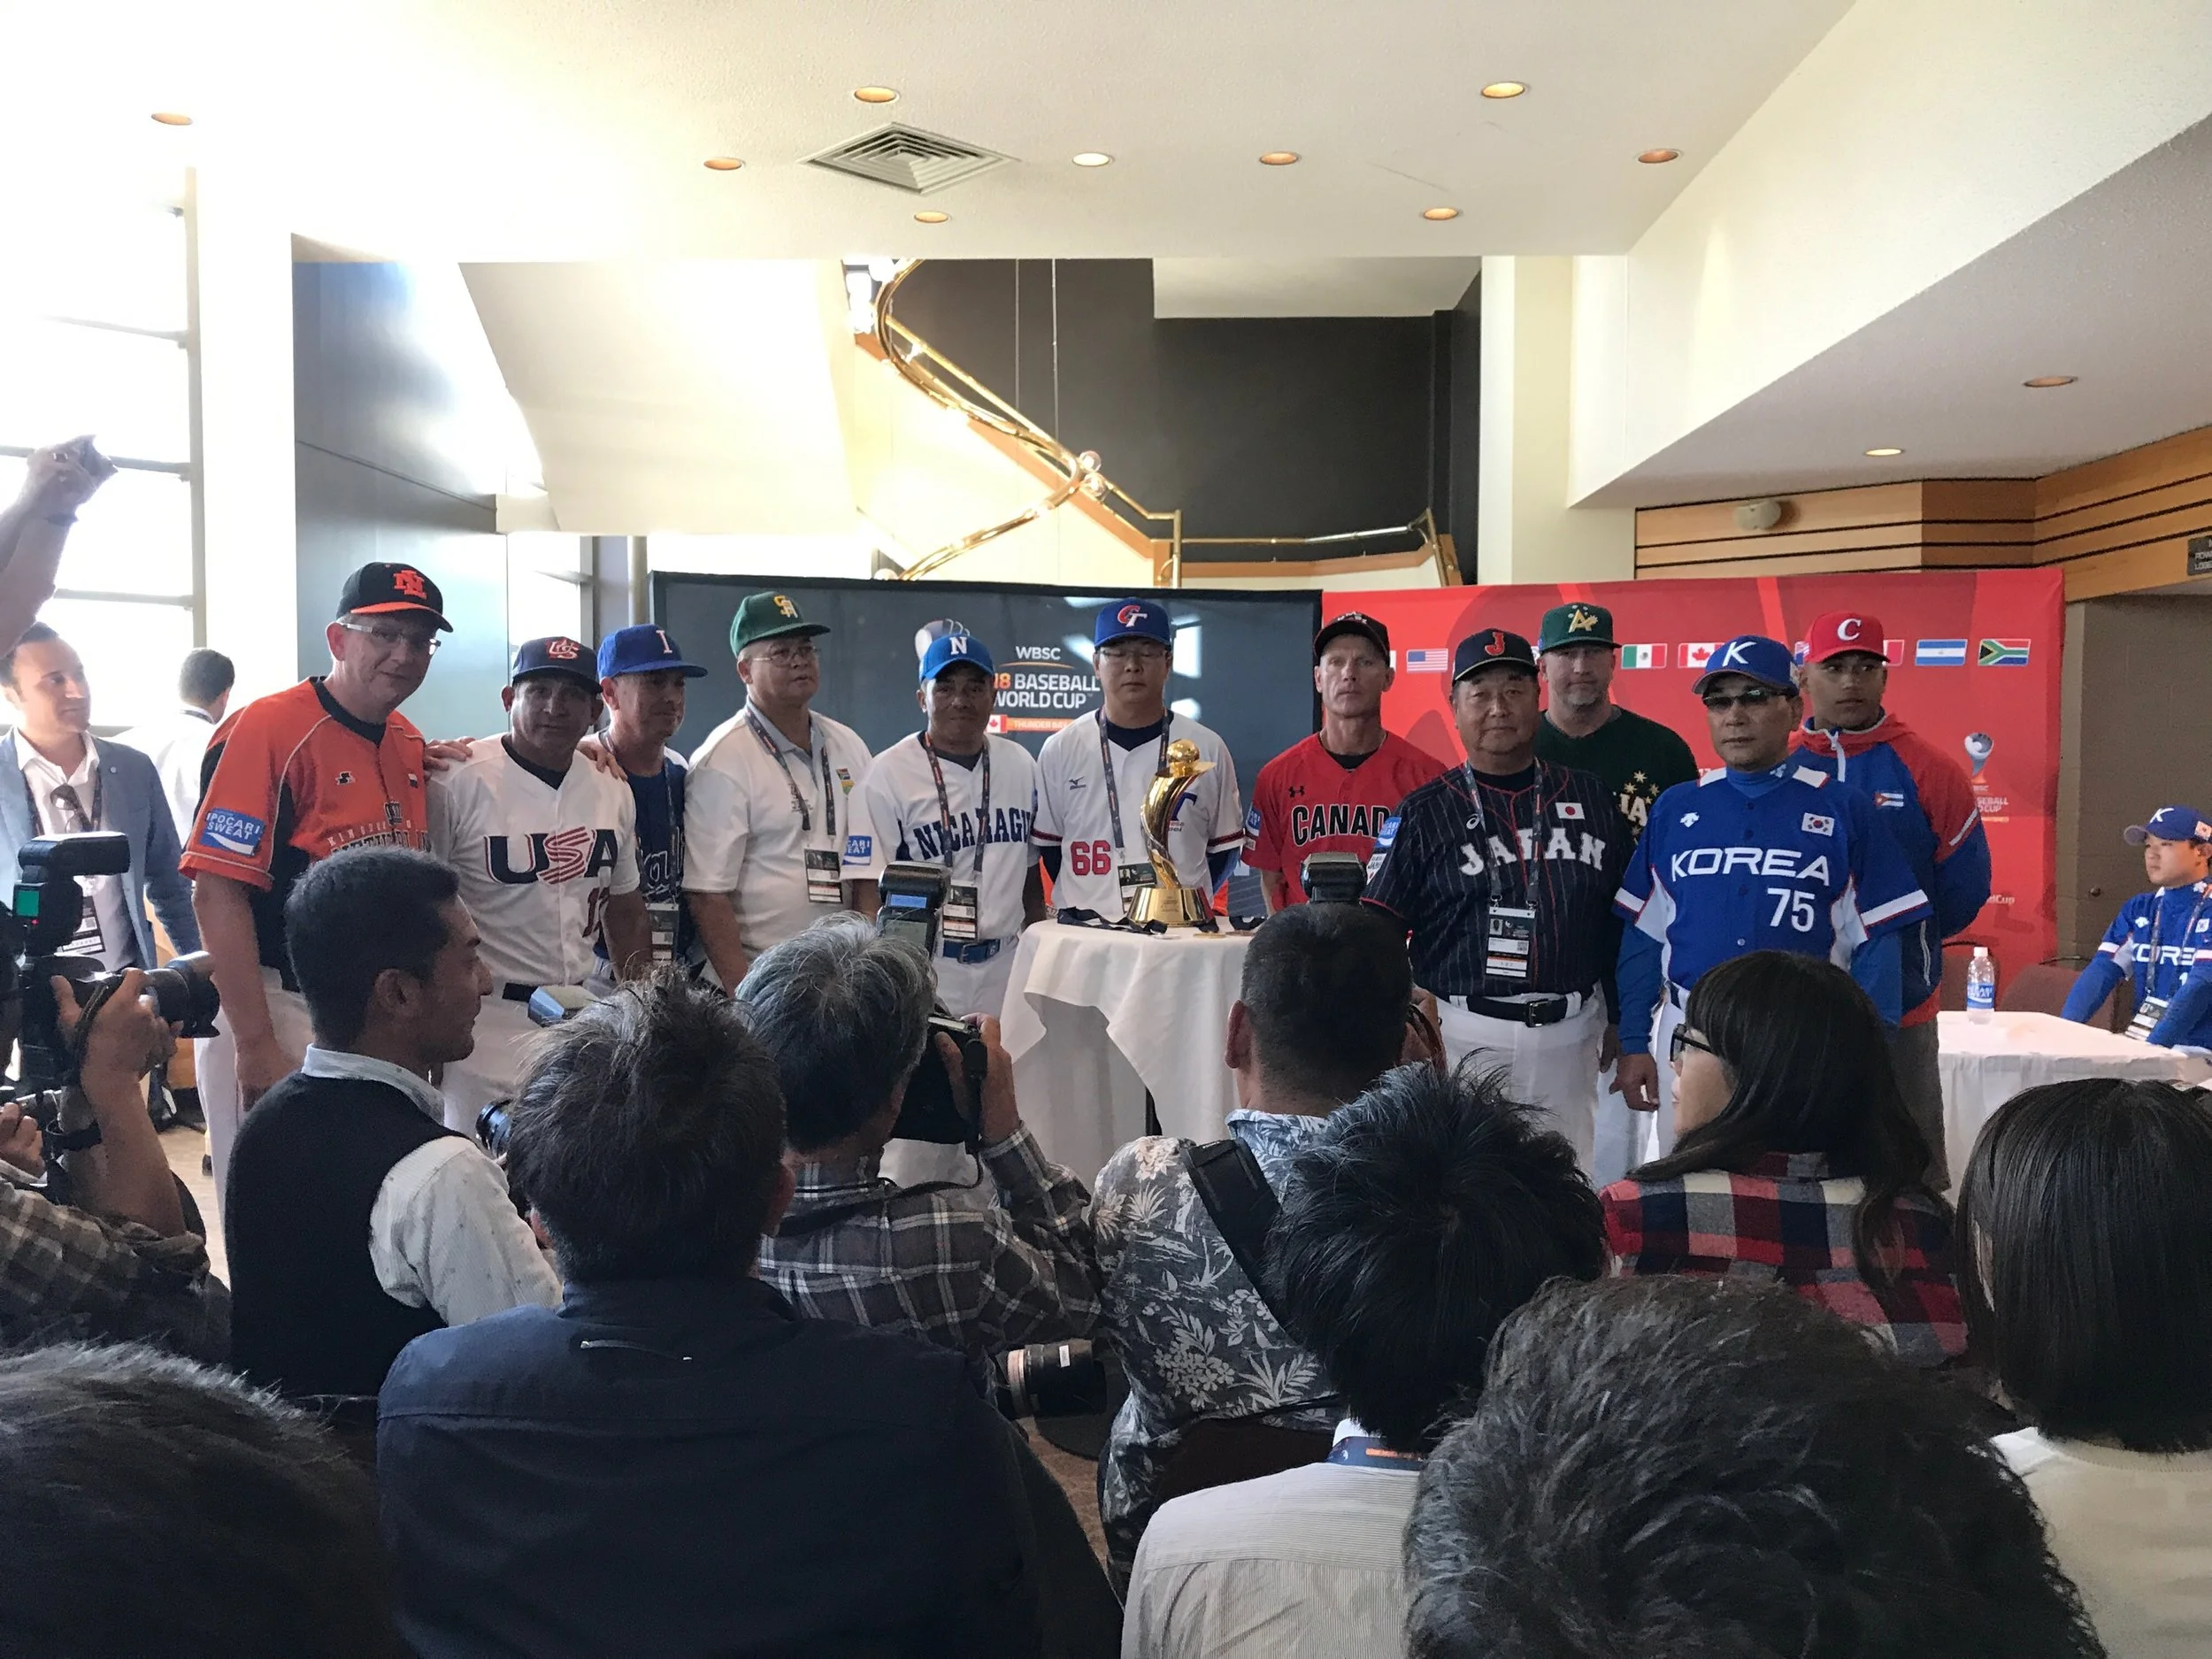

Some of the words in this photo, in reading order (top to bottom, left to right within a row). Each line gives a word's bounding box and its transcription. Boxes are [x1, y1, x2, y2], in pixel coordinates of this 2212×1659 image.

[1836, 618, 1862, 641] C
[656, 630, 673, 654] I
[950, 636, 967, 655] N
[1016, 646, 1062, 660] WBSC
[1484, 631, 1506, 657] J
[1722, 641, 1757, 667] K
[1014, 672, 1101, 692] BASEBALL
[1053, 692, 1087, 709] CUP
[2149, 807, 2175, 824] K
[207, 821, 252, 840] SWEAT
[484, 826, 618, 884] USA
[1071, 840, 1110, 876] 66
[1671, 847, 1830, 887] KOREA
[1767, 887, 1815, 933] 75
